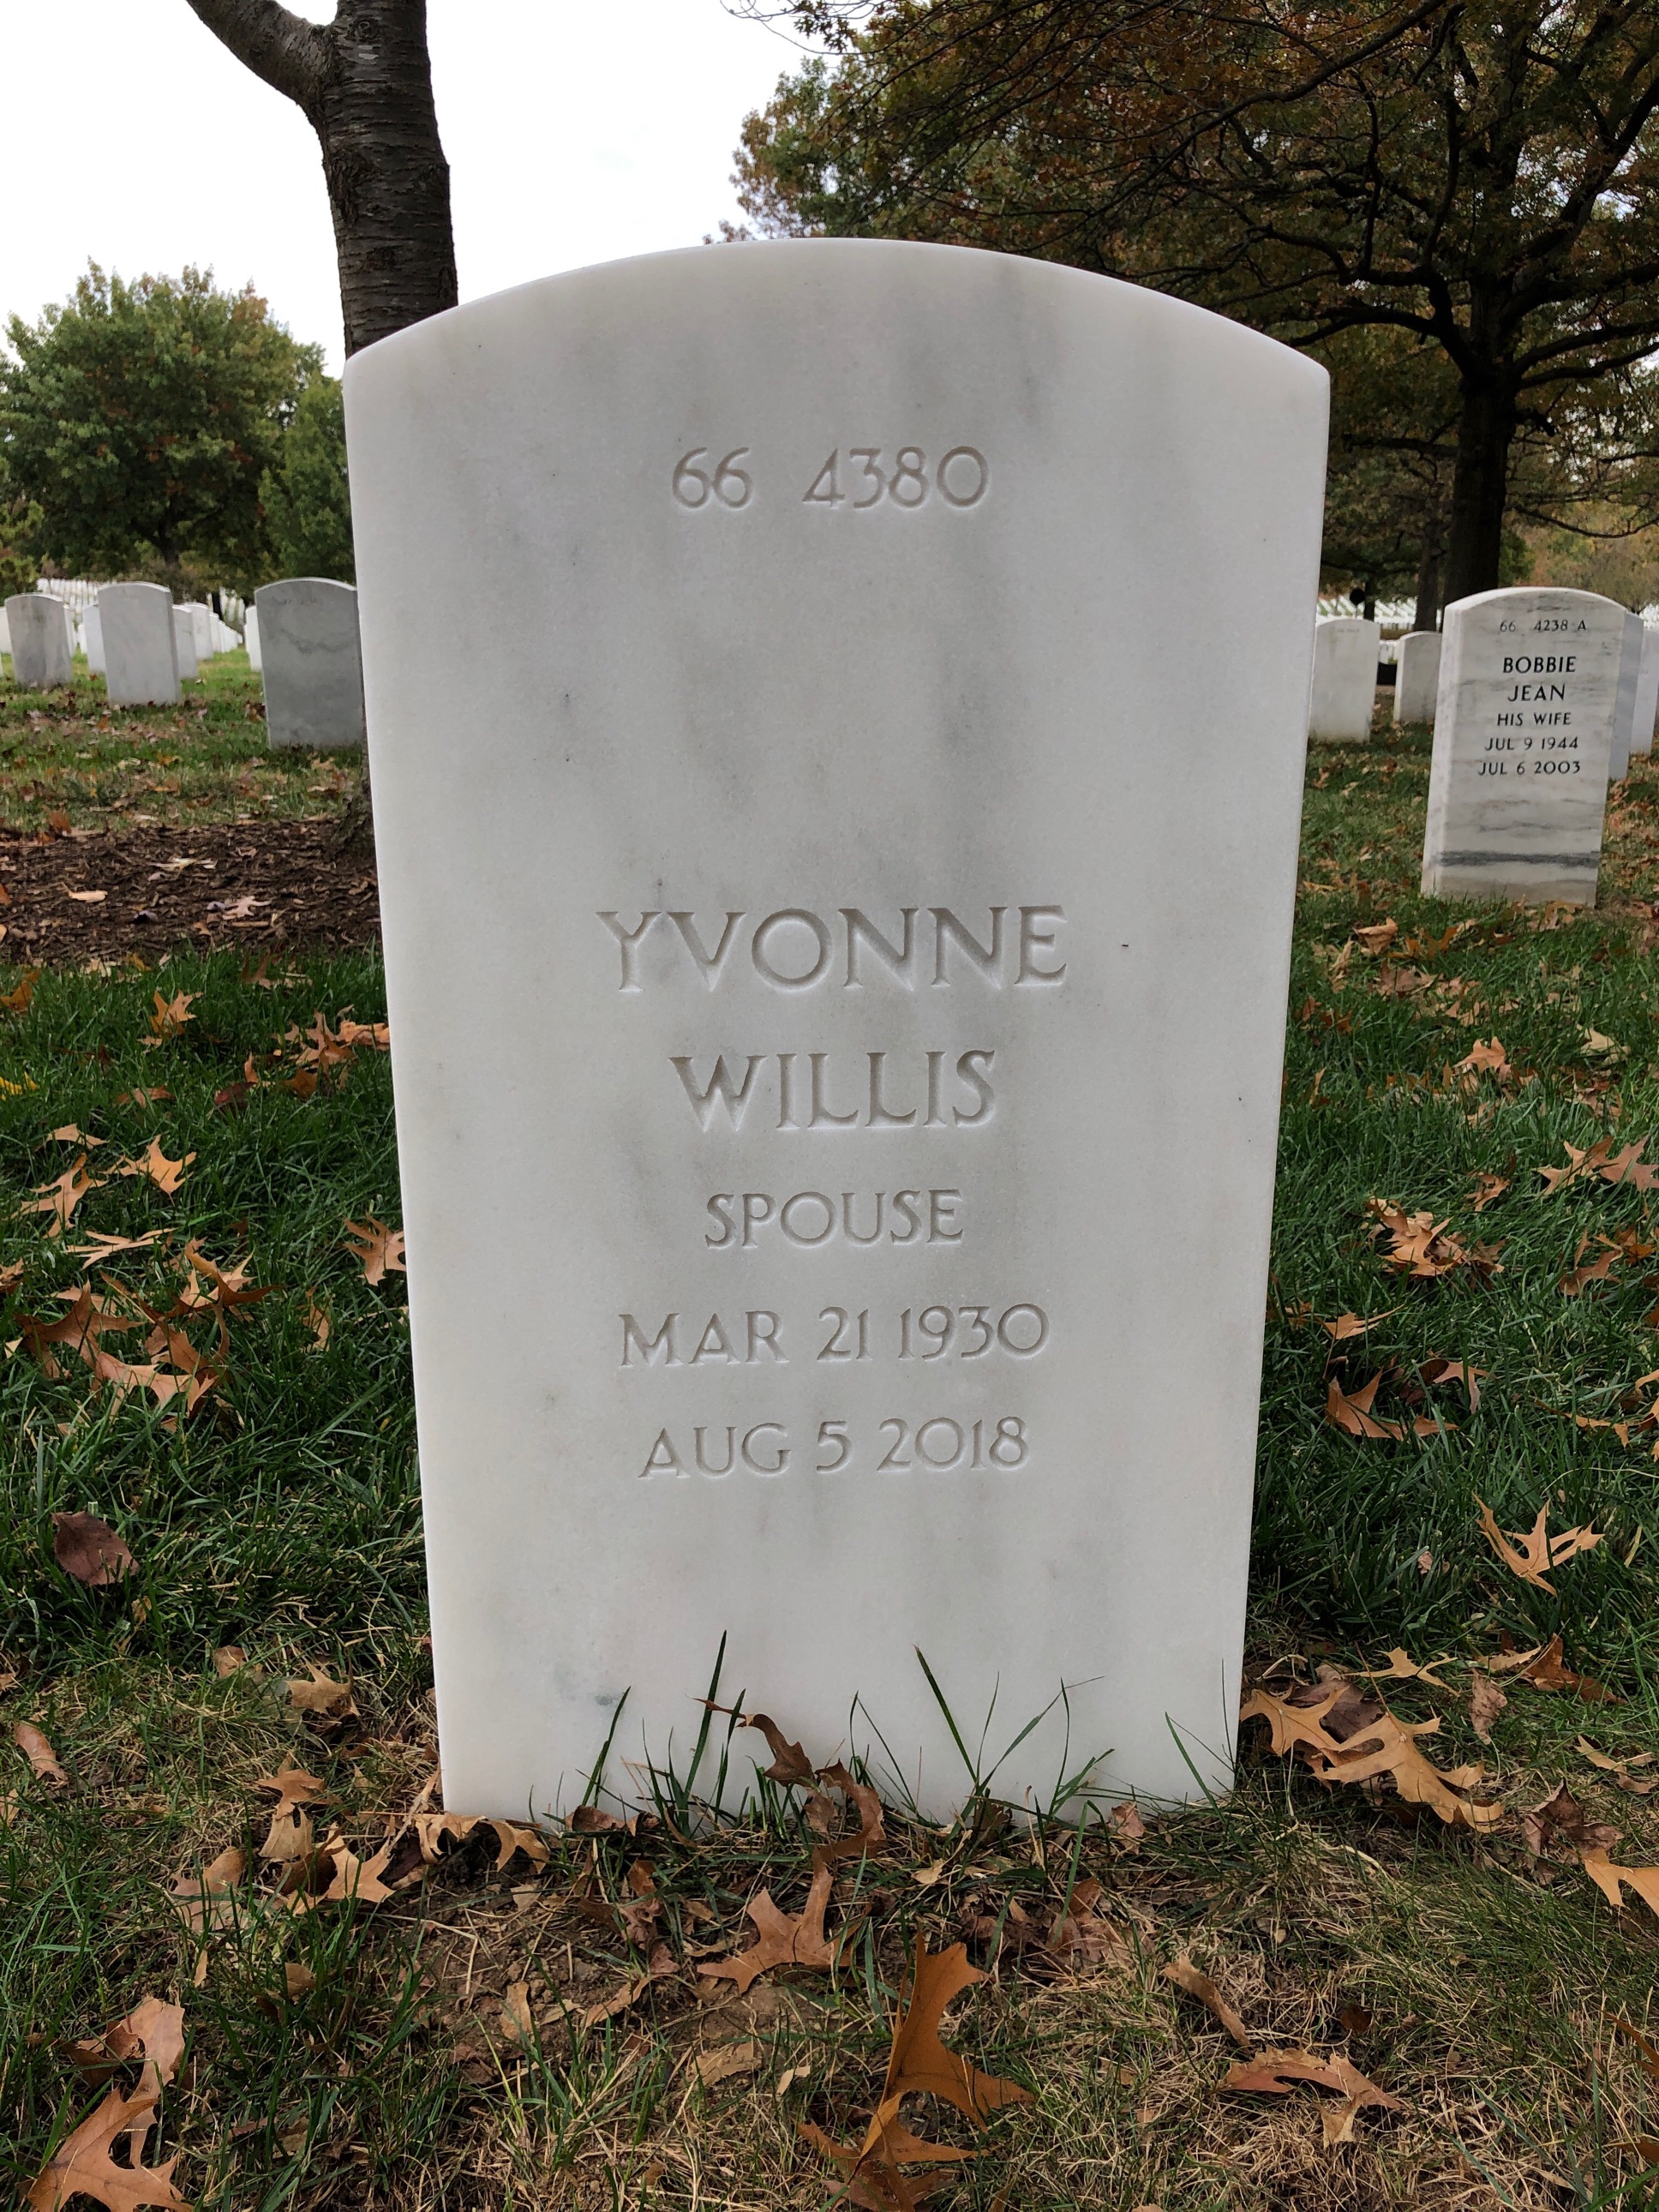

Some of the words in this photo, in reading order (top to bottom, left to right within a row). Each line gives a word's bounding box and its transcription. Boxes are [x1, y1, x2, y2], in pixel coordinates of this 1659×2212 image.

[672, 446, 752, 509] 66
[802, 446, 990, 509] 4380
[1500, 620, 1517, 632] 66
[1502, 656, 1577, 674] BOBBIE
[1507, 684, 1566, 702] JEAN
[1497, 713, 1524, 727] HIS
[1534, 712, 1572, 726] WIFE
[1484, 738, 1515, 751] JUL
[1524, 737, 1533, 751] 9
[1541, 736, 1579, 750] 1944
[1477, 761, 1508, 776] JUL
[1516, 762, 1526, 775] 6
[1534, 760, 1581, 775] 2003
[596, 904, 1068, 992] YVONNE
[668, 1050, 996, 1132] WILLIS
[704, 1189, 965, 1250] SPOUSE
[617, 1310, 790, 1368] MAR
[816, 1306, 873, 1363] 21
[899, 1302, 1051, 1363] 1930
[638, 1423, 792, 1479] AUG
[815, 1420, 853, 1474] 5
[876, 1416, 1029, 1472] 2018
